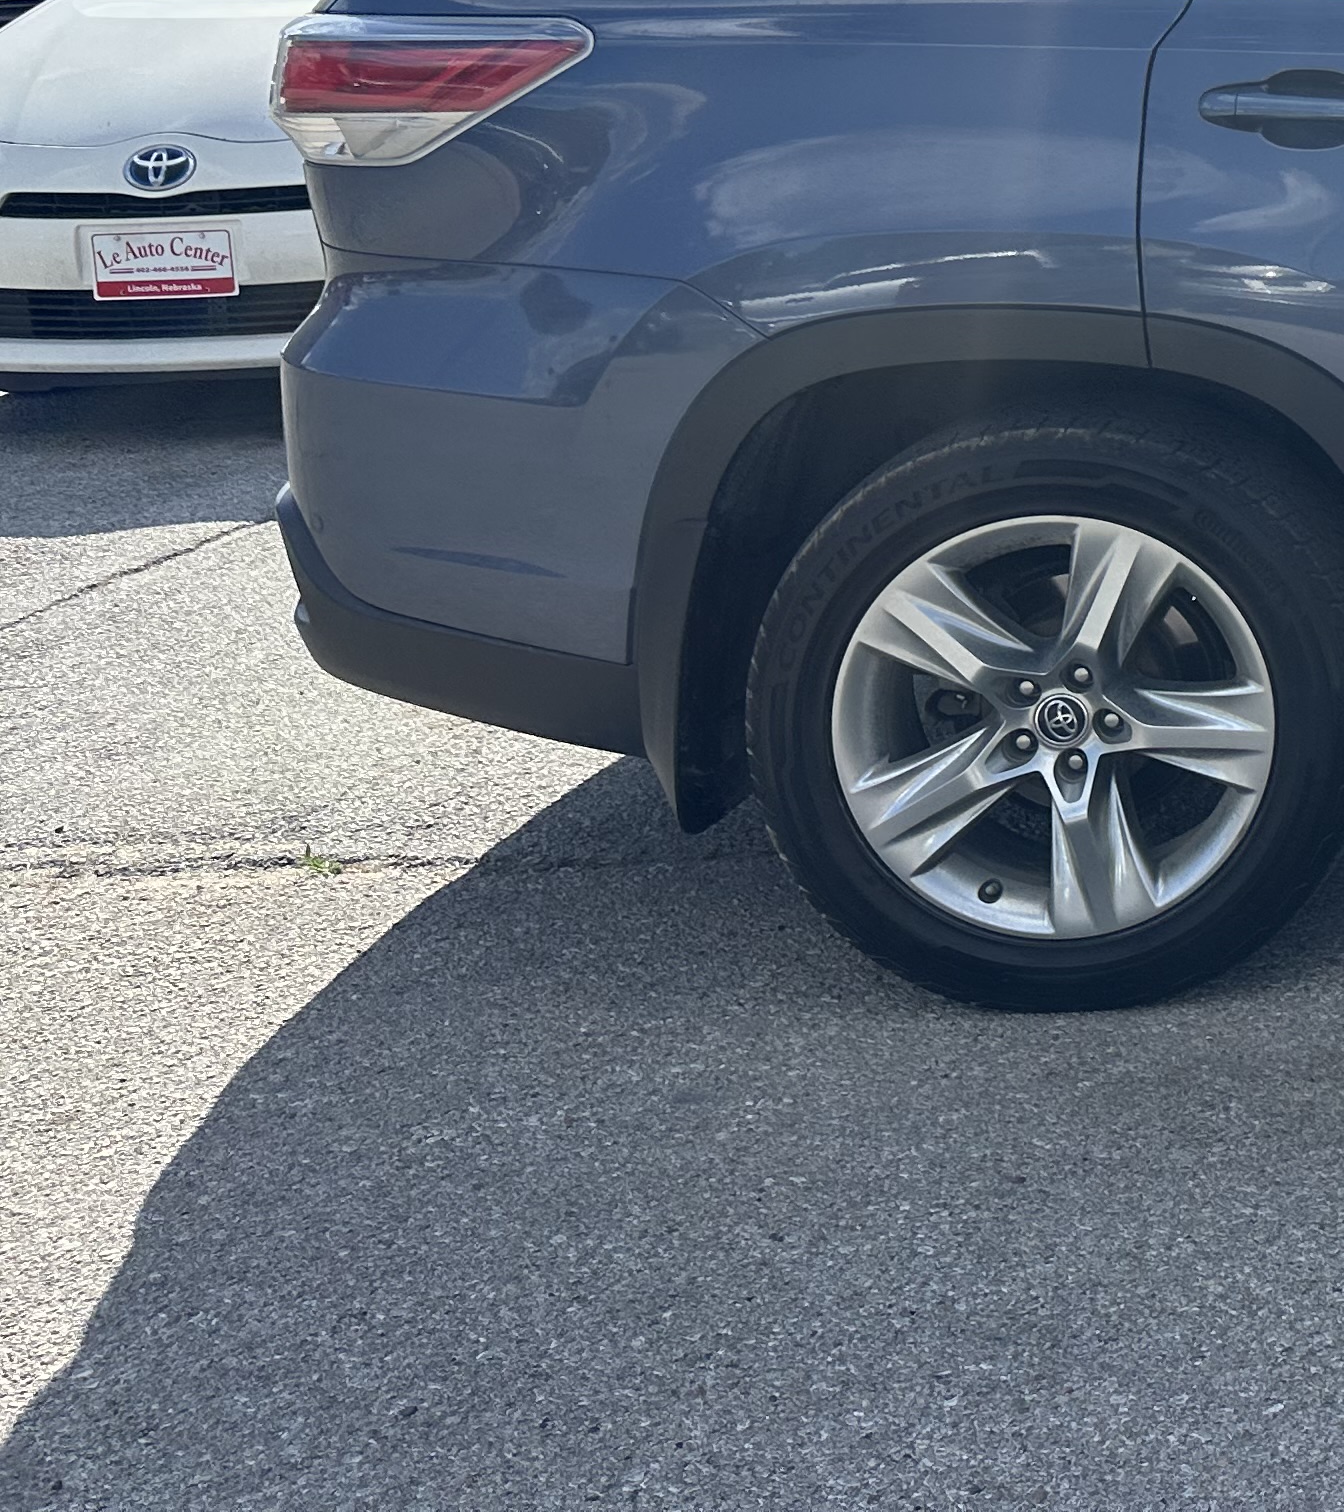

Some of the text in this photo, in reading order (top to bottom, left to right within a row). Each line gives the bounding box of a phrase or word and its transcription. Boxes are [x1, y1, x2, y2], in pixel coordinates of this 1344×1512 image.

[96, 236, 229, 270] Le Auto Center
[779, 465, 1002, 673] CONTINENTAL
